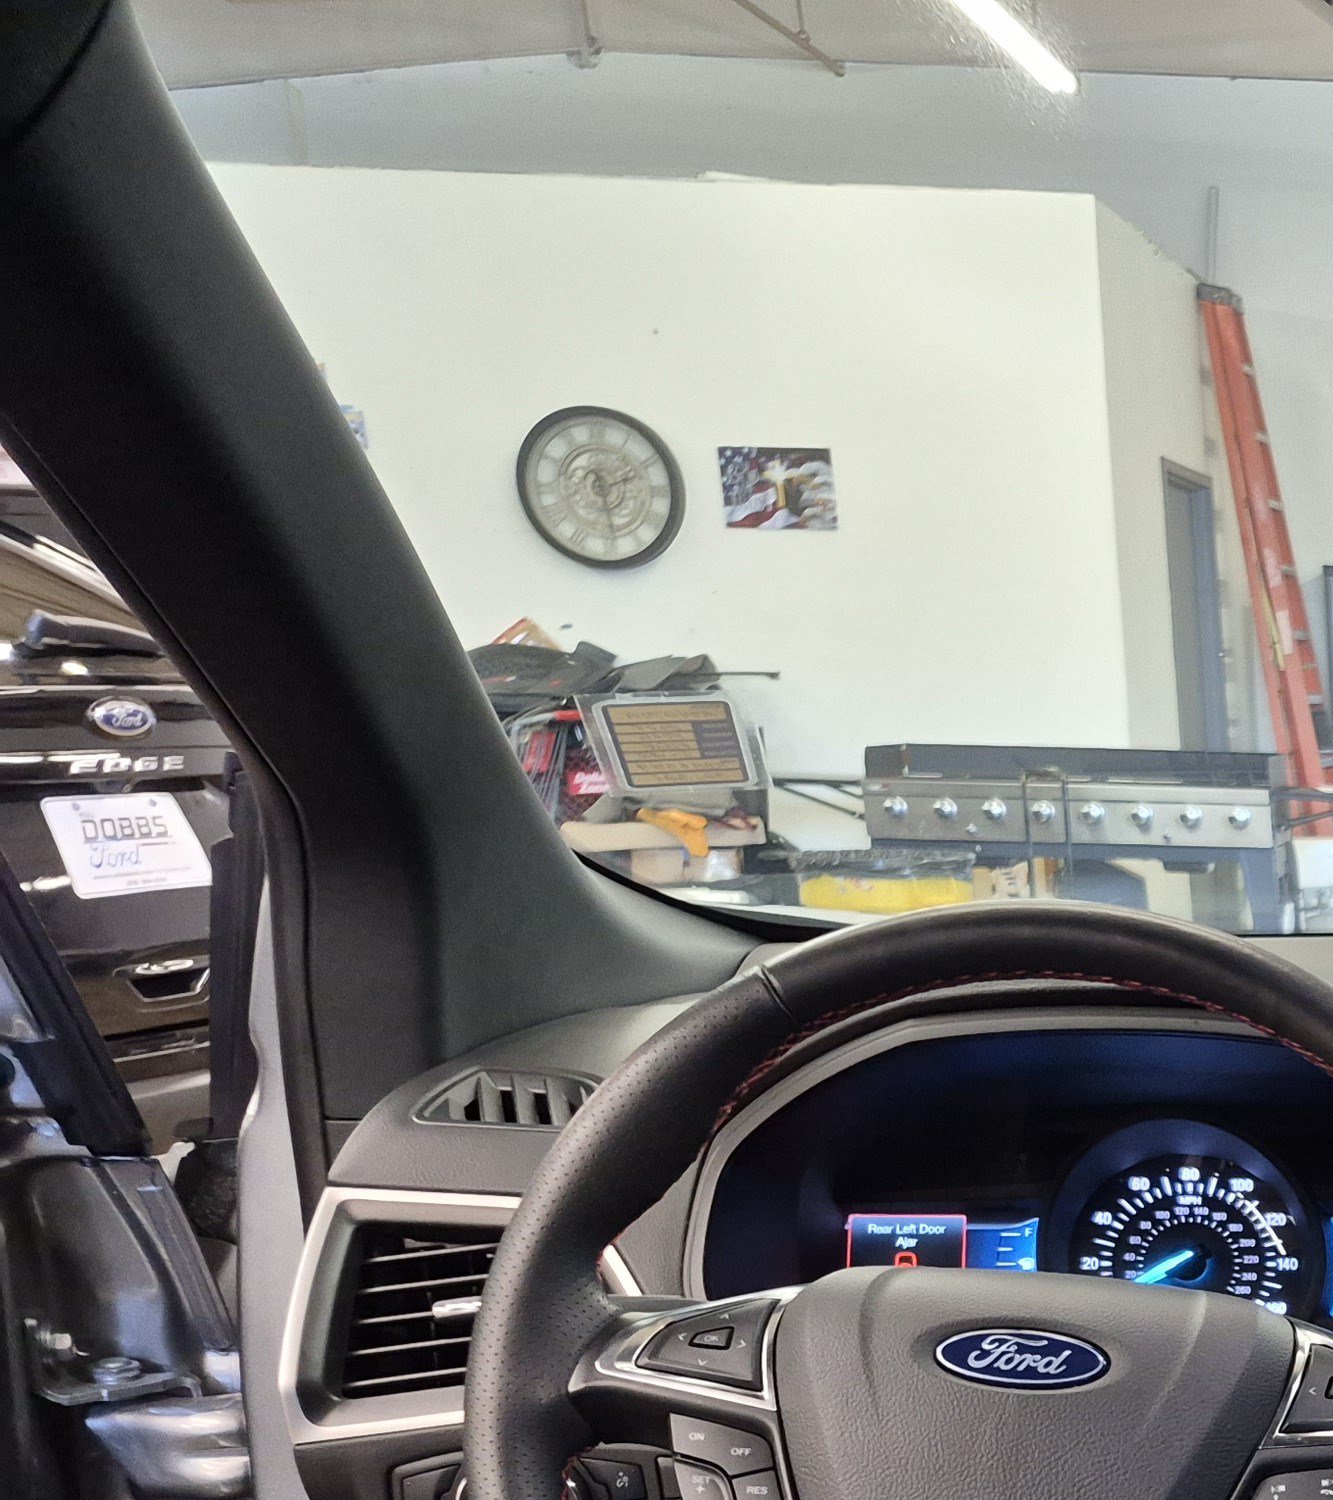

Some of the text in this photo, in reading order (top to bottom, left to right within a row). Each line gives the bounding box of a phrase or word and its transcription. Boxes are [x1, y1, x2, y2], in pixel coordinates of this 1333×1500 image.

[69, 755, 184, 775] EDGE
[81, 816, 168, 842] DOBBS
[89, 842, 143, 868] Ford
[1178, 1167, 1200, 1181] 80
[1128, 1177, 1150, 1191] 60
[1229, 1178, 1253, 1192] 100
[1177, 1196, 1202, 1205] MPH
[1174, 1207, 1189, 1216] 120
[1091, 1211, 1112, 1226] 40
[1265, 1213, 1286, 1226] 120
[867, 1223, 946, 1234] Rear Left Door
[1024, 1229, 1033, 1237] F
[895, 1237, 918, 1249] Ajar
[1123, 1252, 1135, 1261] 40
[1243, 1255, 1259, 1264] 220
[1079, 1257, 1099, 1270] 20
[1277, 1258, 1298, 1271] 140
[967, 1334, 1072, 1374] Ford
[688, 1432, 705, 1440] ON
[730, 1448, 752, 1456] OFF
[691, 1475, 711, 1483] SET
[746, 1486, 768, 1494] RES
